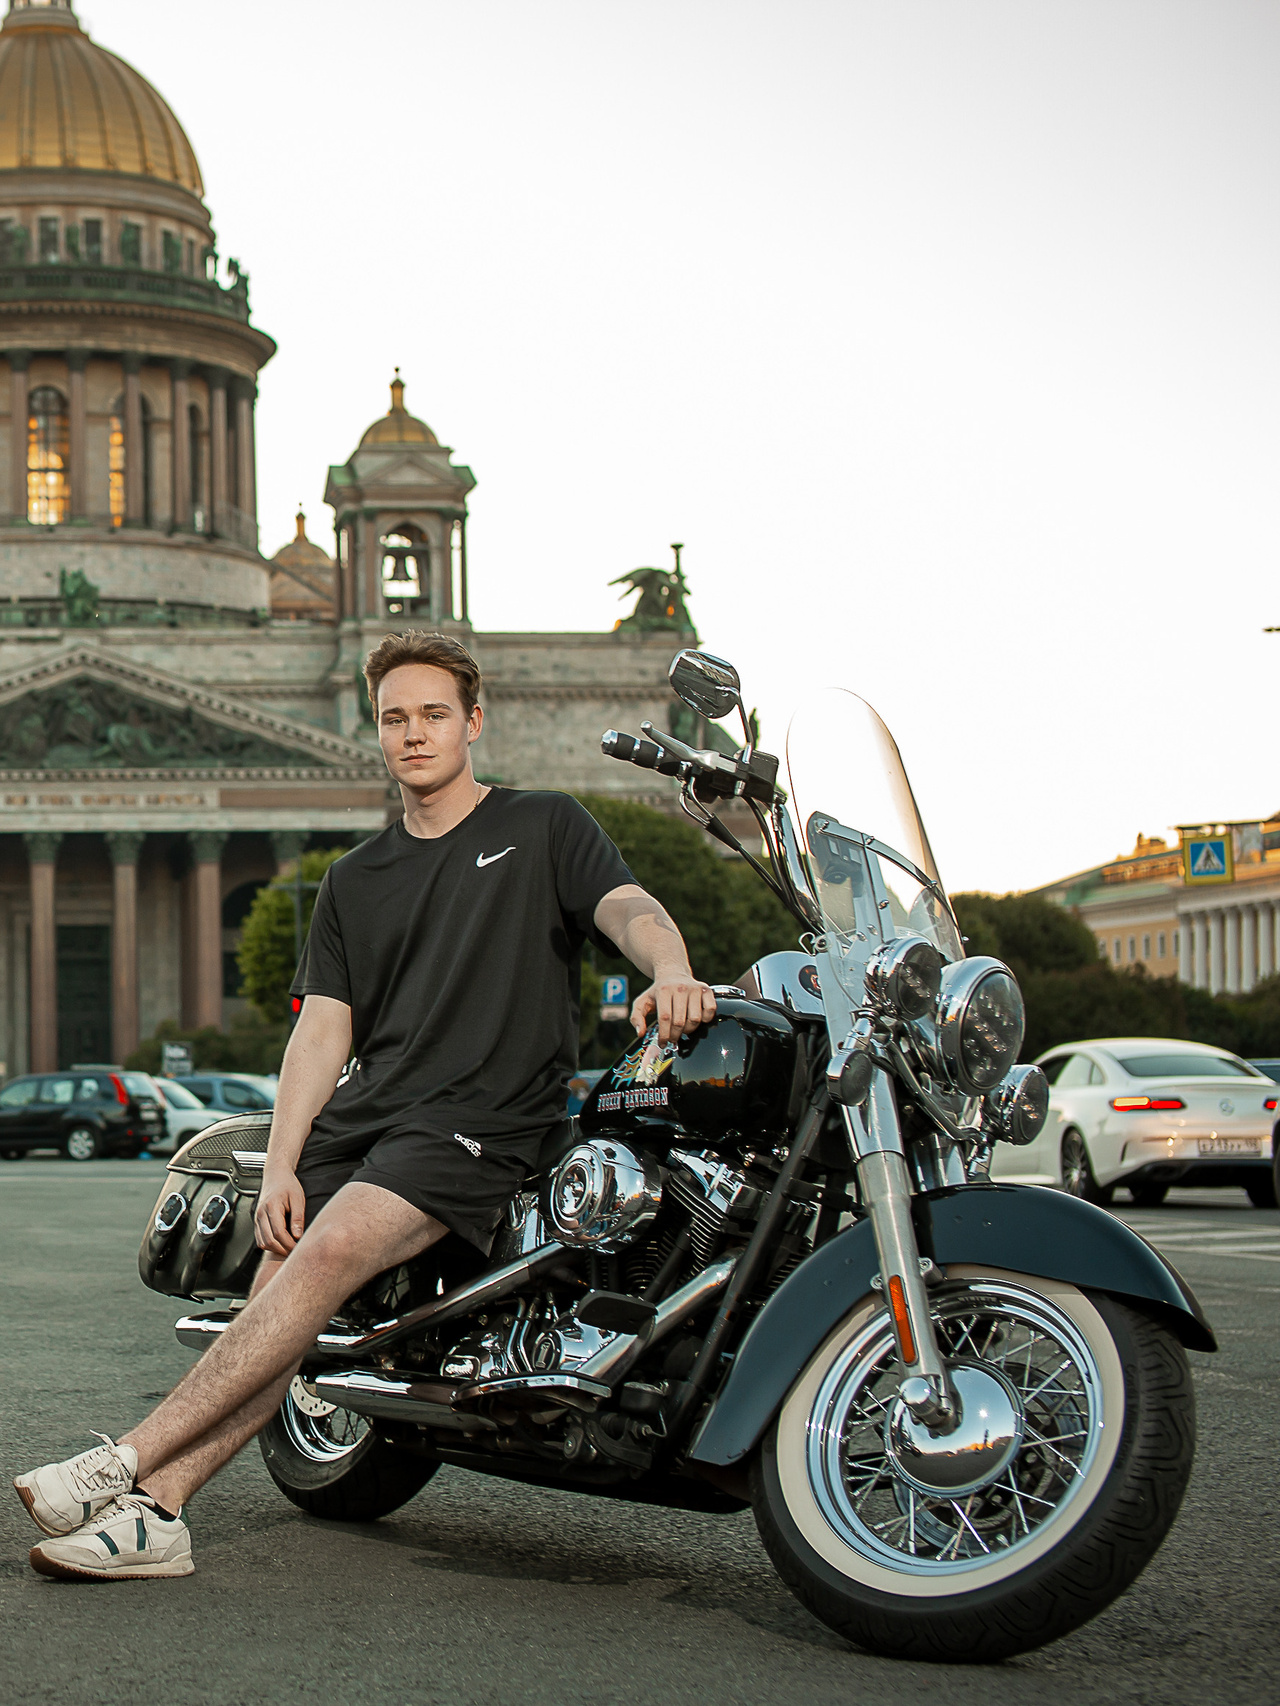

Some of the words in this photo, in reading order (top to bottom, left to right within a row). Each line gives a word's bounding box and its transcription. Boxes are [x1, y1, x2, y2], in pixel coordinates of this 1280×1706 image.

[607, 978, 623, 1003] P
[625, 1087, 669, 1109] DAVIDSON
[454, 1133, 482, 1157] adidas
